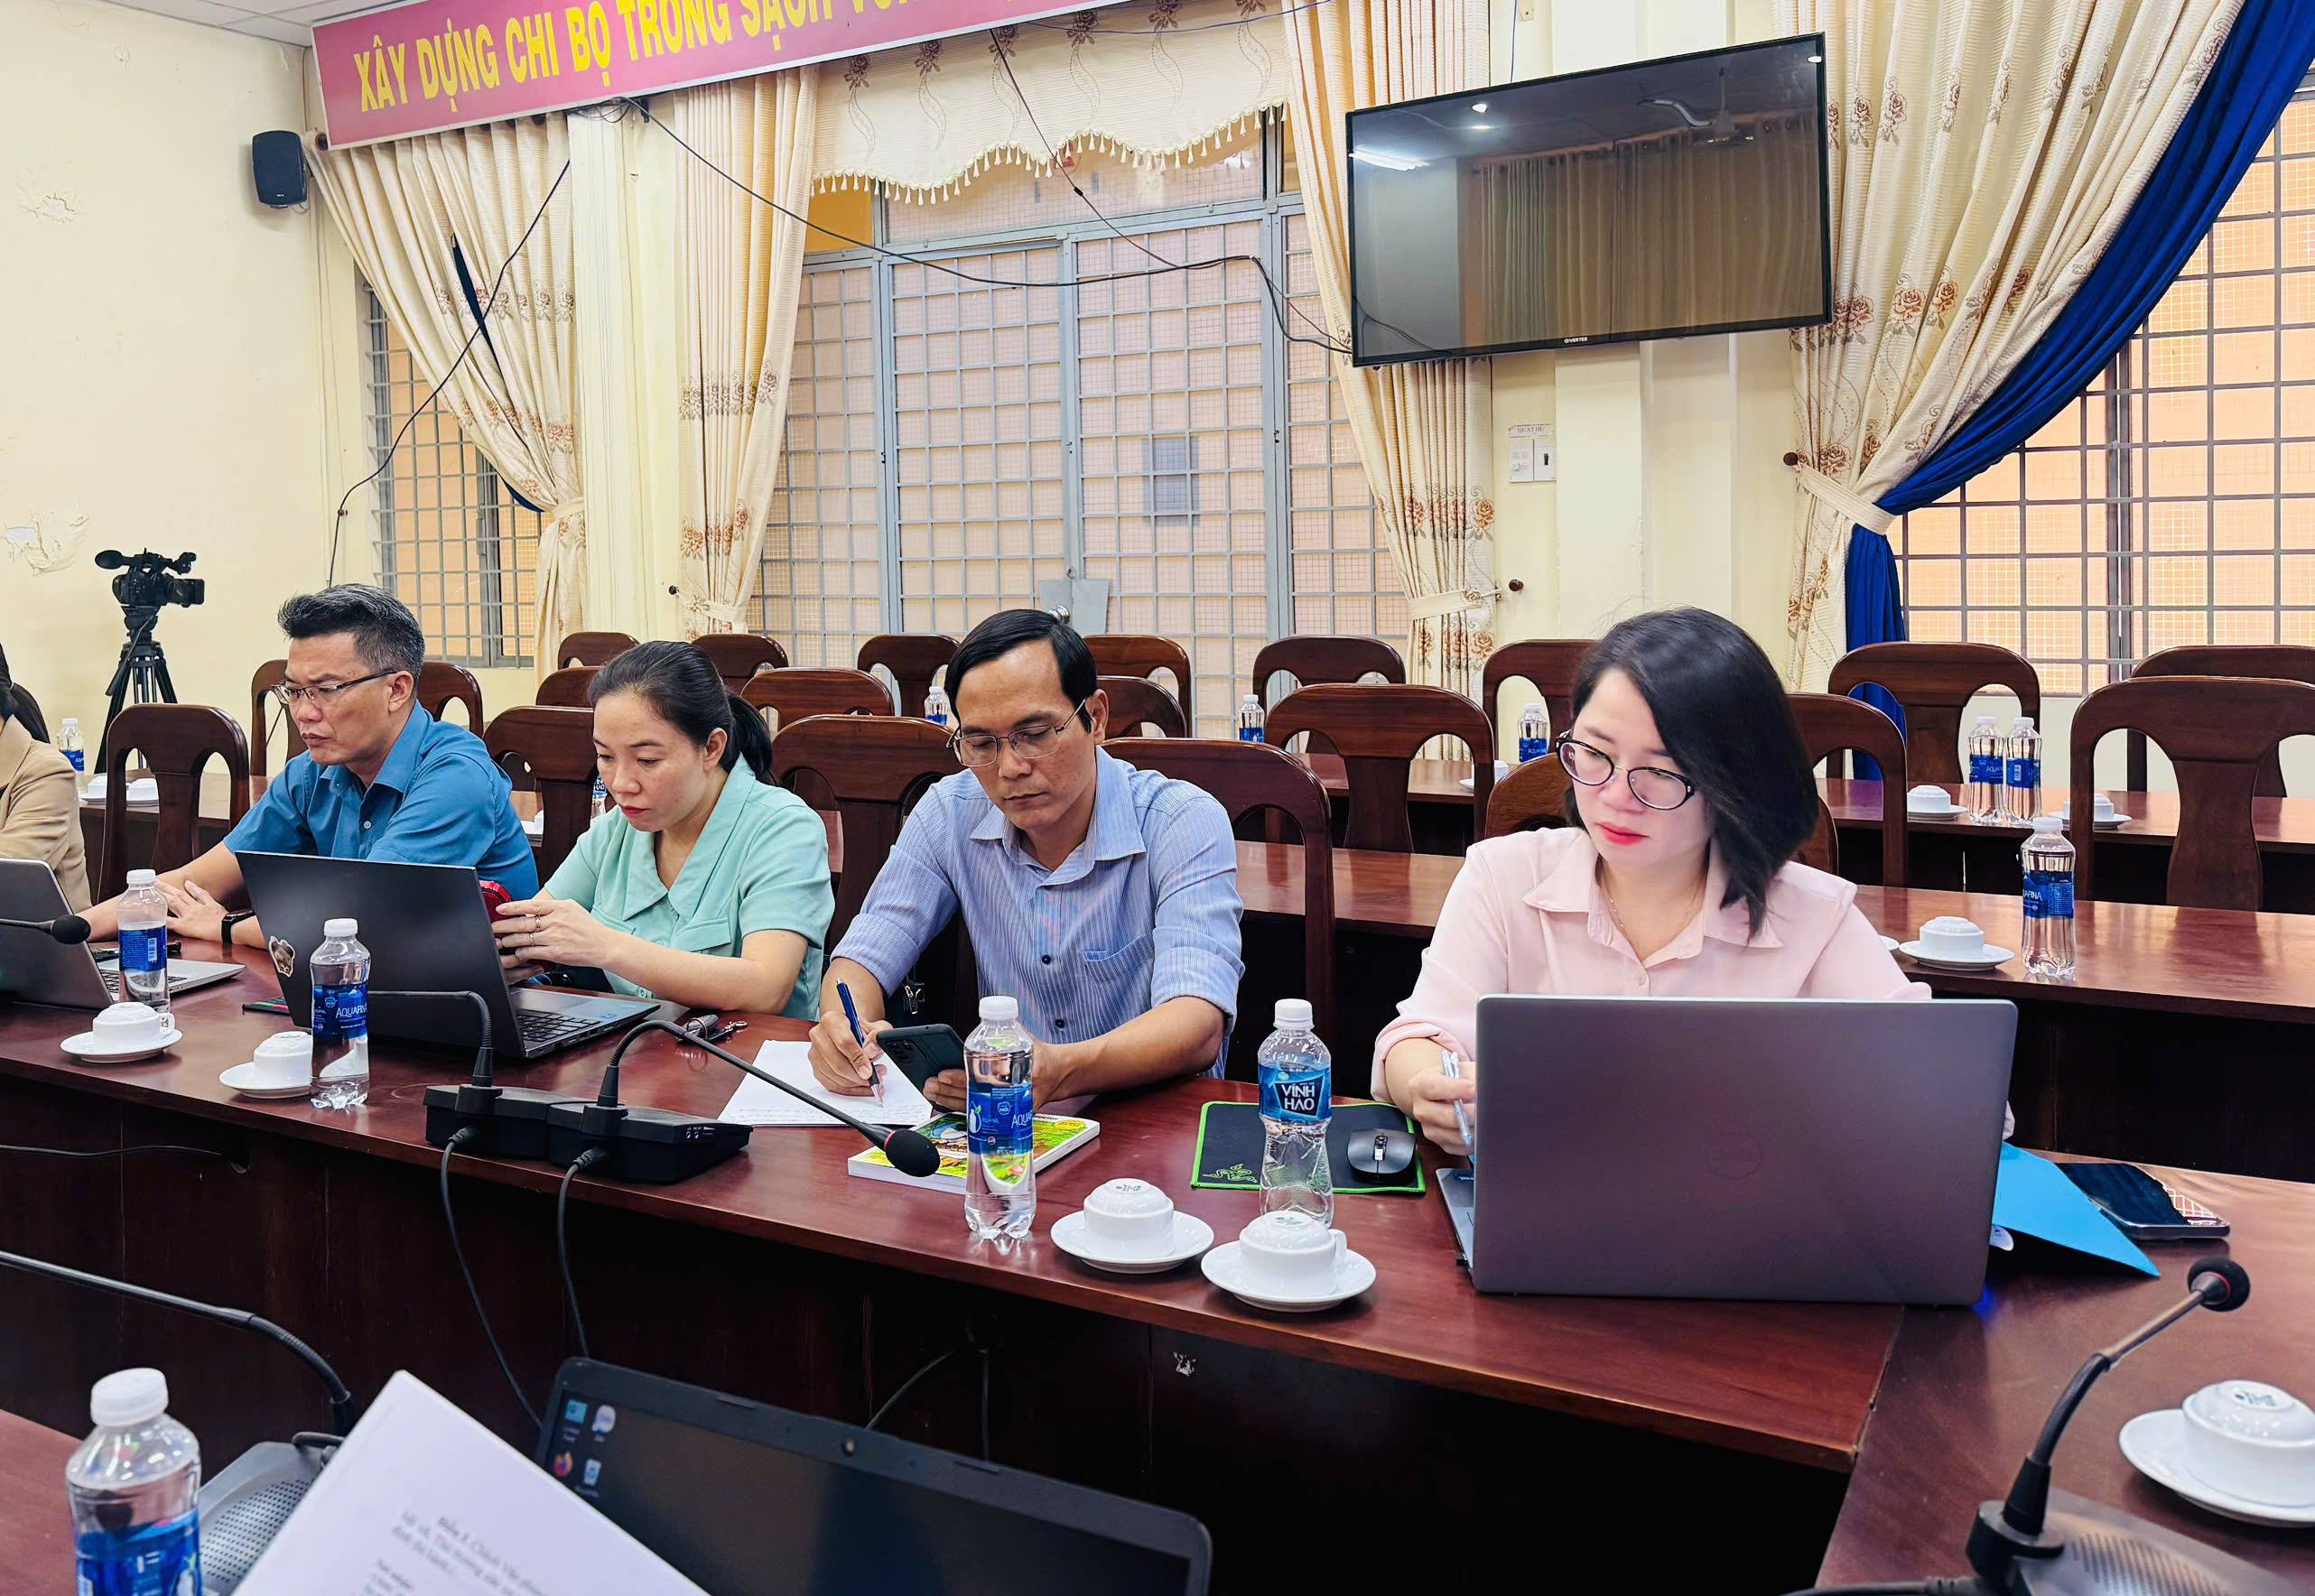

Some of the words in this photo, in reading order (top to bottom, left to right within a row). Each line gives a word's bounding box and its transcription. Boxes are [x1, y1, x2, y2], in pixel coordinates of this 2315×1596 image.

[354, 35, 408, 112] XÂY
[415, 18, 500, 112] DỰNG
[505, 12, 560, 84] CHI
[617, 0, 732, 61] TRONG
